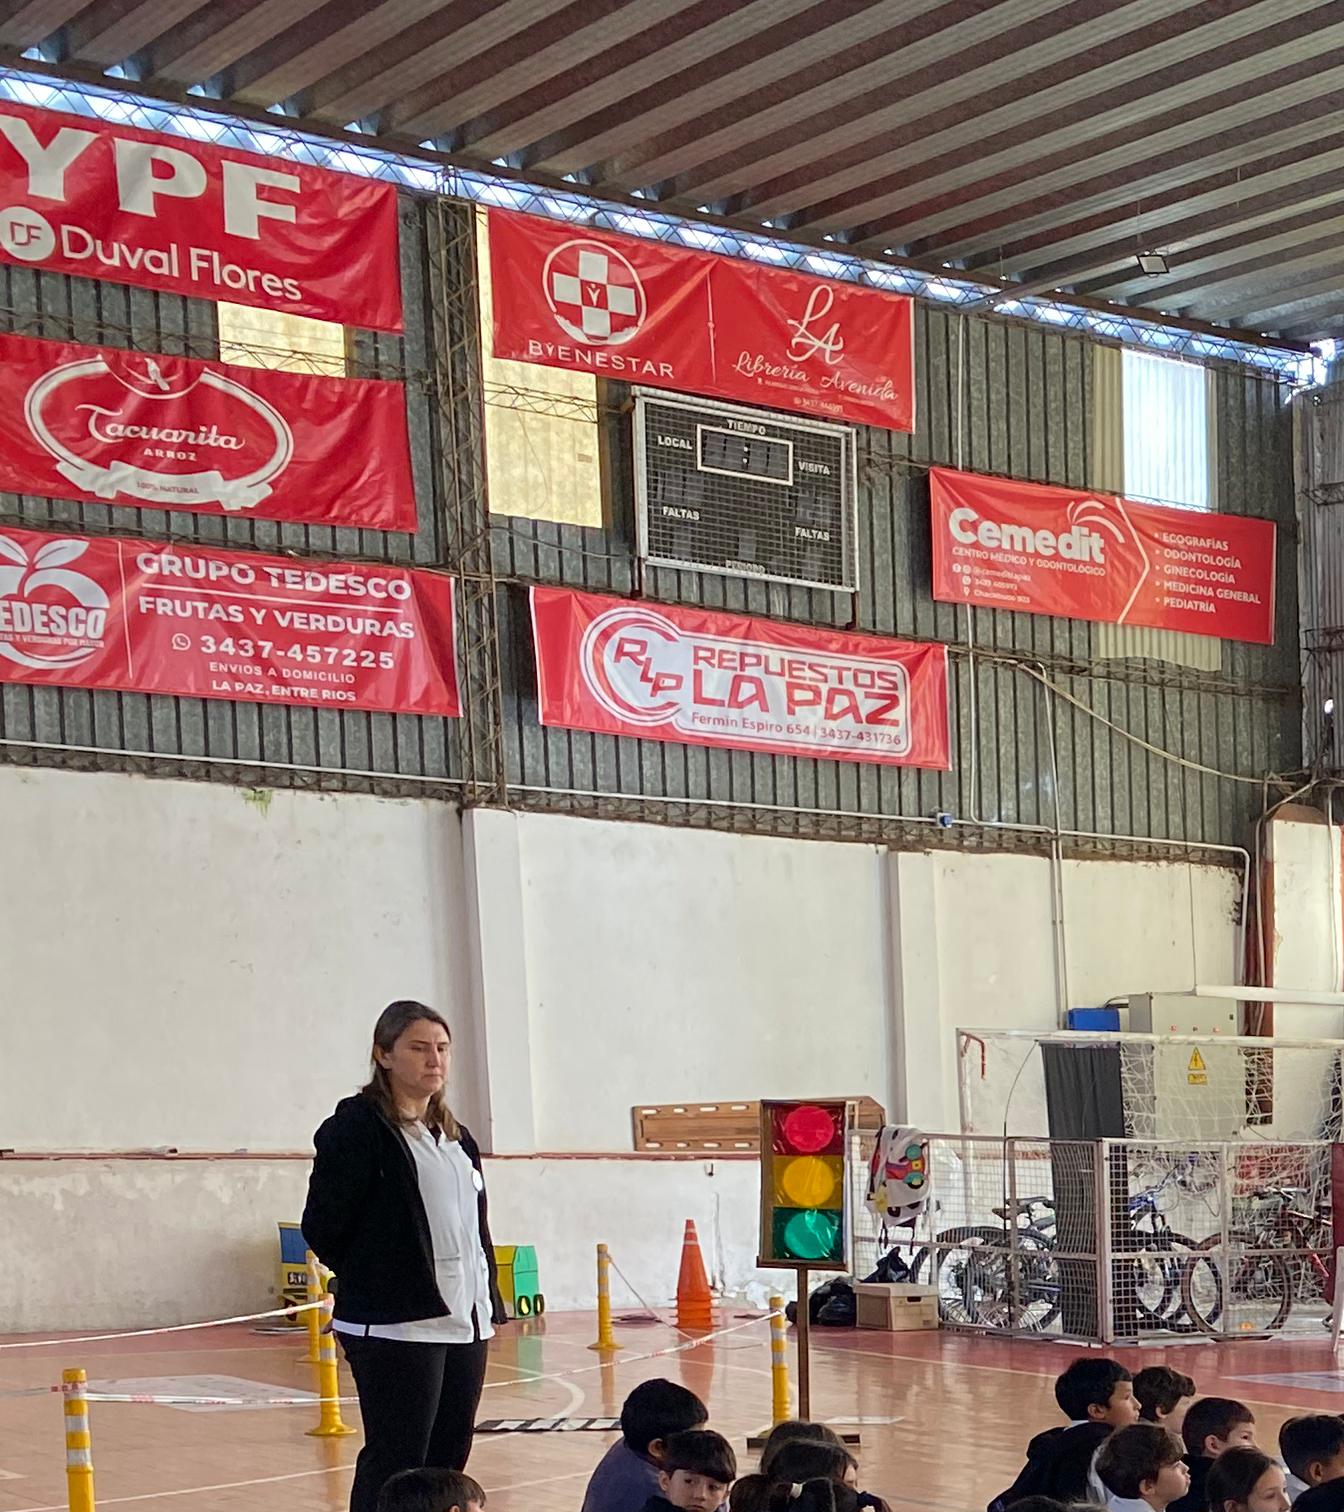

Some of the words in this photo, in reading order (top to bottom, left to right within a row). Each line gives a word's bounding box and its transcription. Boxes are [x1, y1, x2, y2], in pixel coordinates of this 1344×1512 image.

[0, 114, 301, 241] YPF
[61, 224, 179, 278] Duval
[189, 247, 302, 300] Flores
[820, 371, 898, 401] Avenida
[75, 402, 246, 452] Tacuarita
[727, 419, 767, 436] TIEMPO
[143, 447, 197, 461] ARROZ
[658, 435, 693, 450] LOCAL
[798, 461, 830, 476] VISITA
[663, 506, 700, 521] FALTAS
[795, 526, 830, 542] FALTAS
[948, 507, 1106, 565] Cemedit
[1162, 532, 1229, 551] ECOGRAFÍAS
[952, 547, 989, 560] CENTRO
[1028, 558, 1034, 567] Y
[1164, 548, 1242, 569] ODONTOLOGÍA
[136, 552, 256, 585] GRUPO
[262, 566, 412, 600] TEDESCO
[1164, 564, 1236, 584] GINECOLOGÍA
[1164, 580, 1214, 597] MEDICINA
[1216, 588, 1262, 604] GENERAL
[1163, 596, 1216, 613] PEDIATRÍA
[138, 595, 245, 623] FRUTAS
[249, 607, 267, 625] Y
[273, 610, 415, 639] VERDURAS
[200, 635, 395, 670] 3437-457225
[209, 661, 262, 677] ENVIOS
[267, 667, 278, 678] A
[282, 669, 356, 684] DOMICILIO
[693, 645, 899, 692] REPUESTOS
[212, 680, 232, 692] LA
[272, 685, 318, 699] ENTRE
[321, 689, 357, 702] RIOS
[693, 668, 770, 713] LA
[786, 680, 901, 727] PAZ
[742, 716, 783, 734] Espiro
[786, 724, 810, 737] 654
[820, 729, 901, 747] 3437-431736
